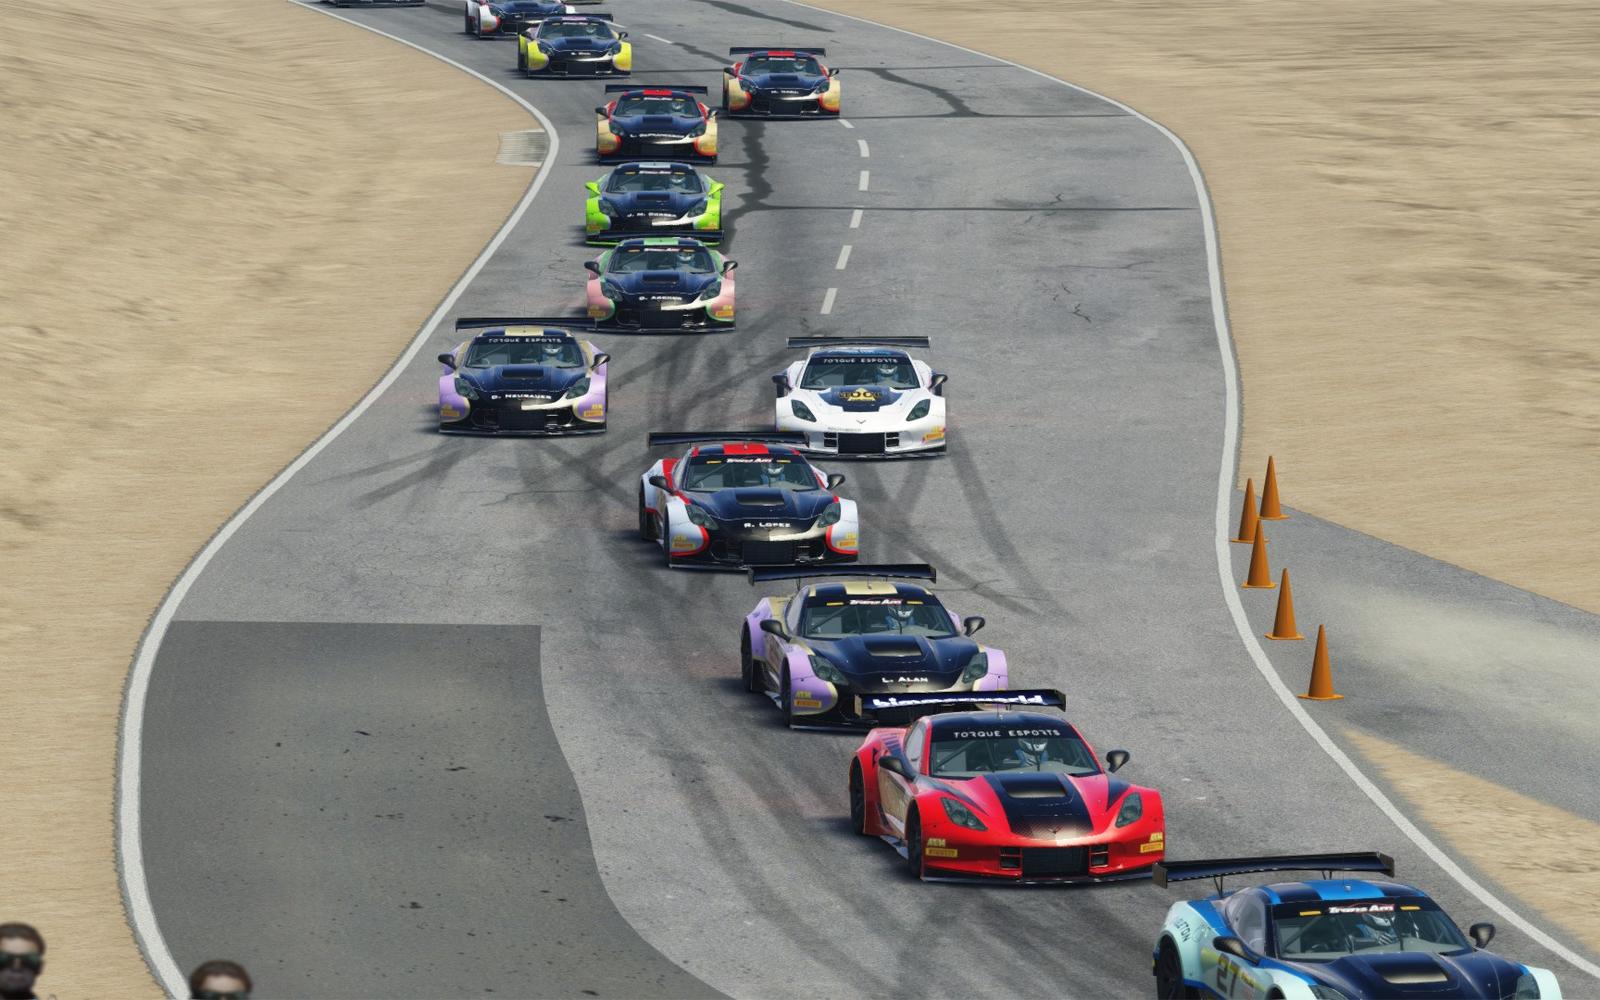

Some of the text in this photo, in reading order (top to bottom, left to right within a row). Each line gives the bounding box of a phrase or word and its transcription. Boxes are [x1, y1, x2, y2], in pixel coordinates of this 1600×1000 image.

[953, 729, 1061, 739] TORQUE ESPORTS
[1368, 904, 1396, 912] Am
[1216, 953, 1240, 999] 27
